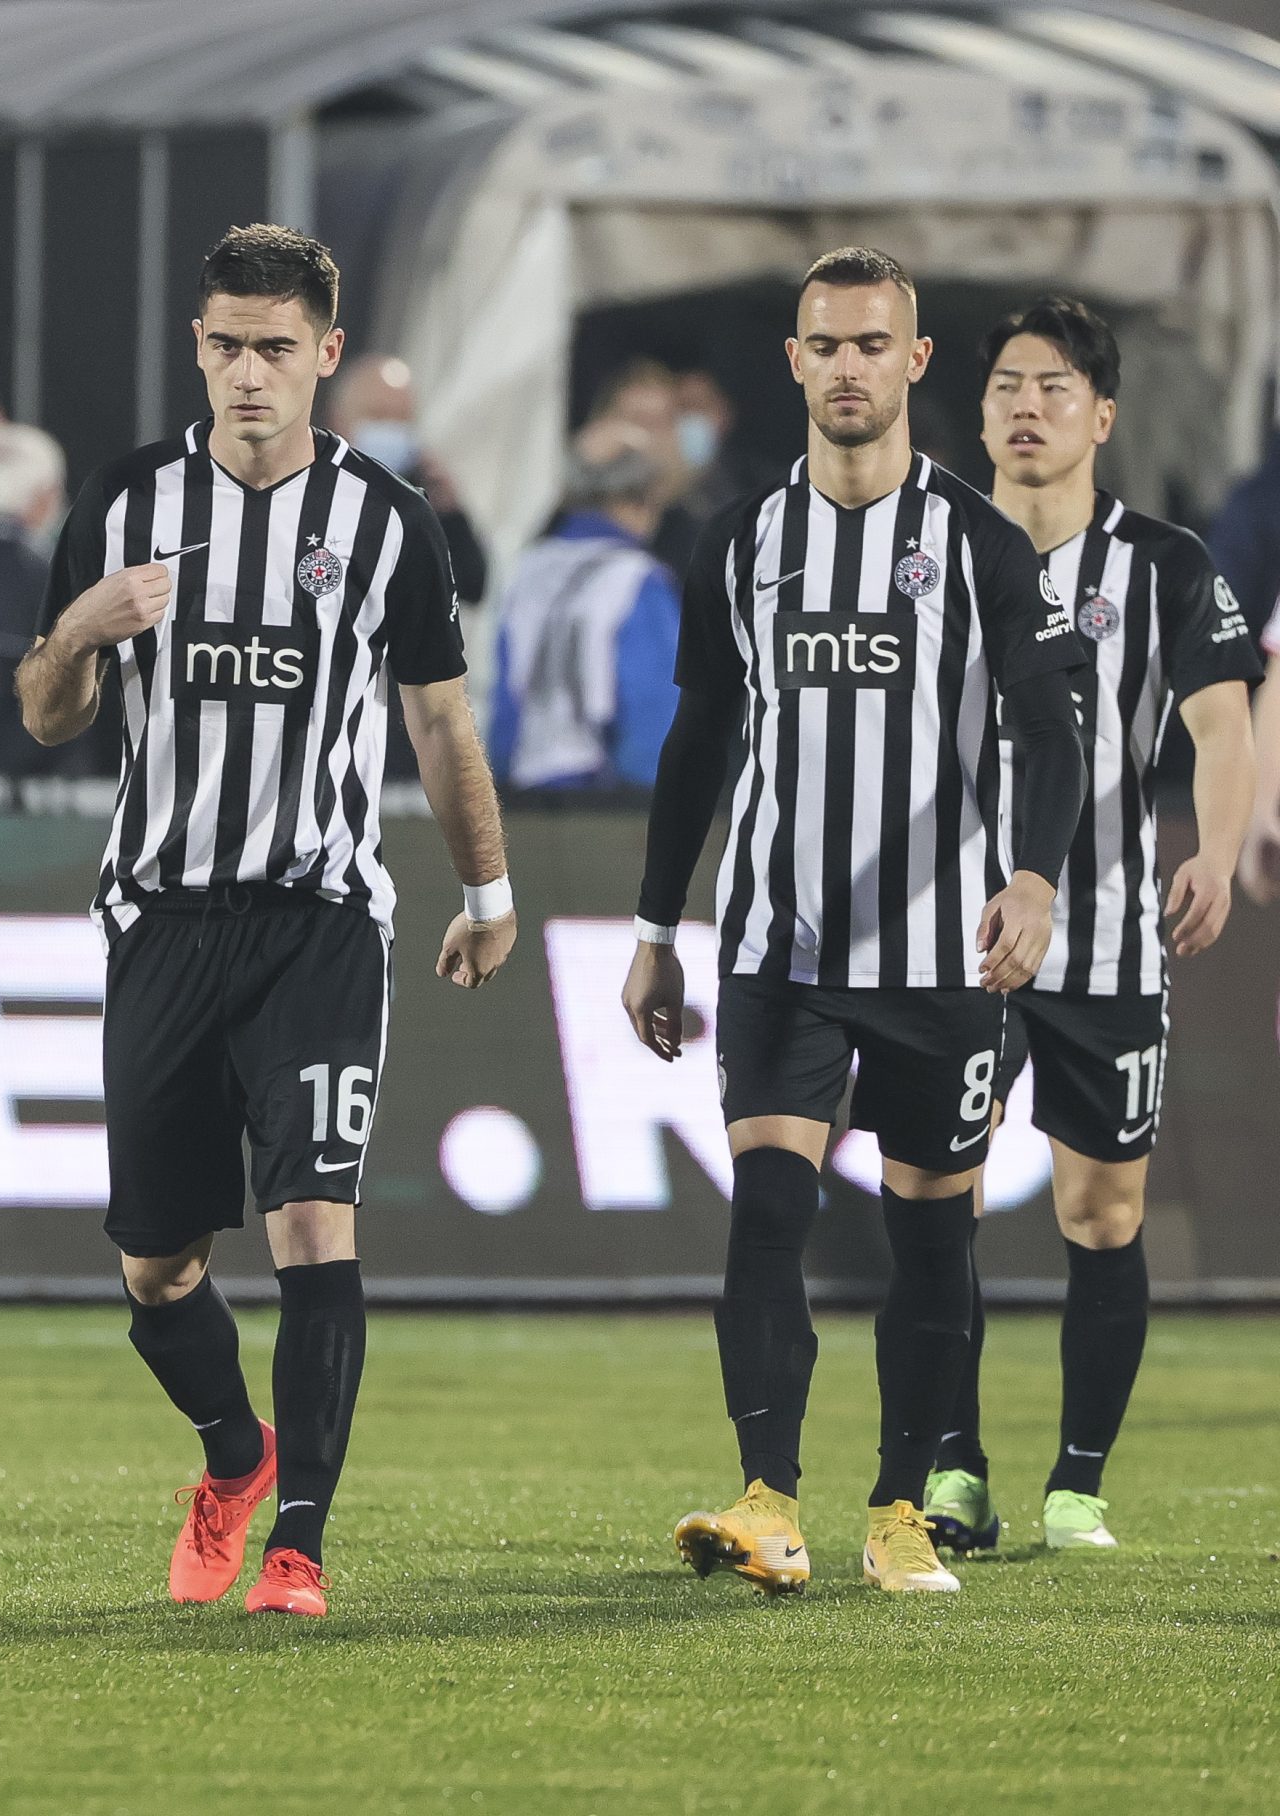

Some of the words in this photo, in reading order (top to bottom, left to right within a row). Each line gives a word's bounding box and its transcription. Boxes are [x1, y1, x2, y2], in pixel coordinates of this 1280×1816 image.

[1035, 622, 1071, 642] ОСИГУ
[1046, 610, 1068, 627] ДУН
[186, 635, 304, 689] mts
[786, 623, 901, 674] mts
[299, 1063, 373, 1145] 16
[959, 1049, 995, 1122] 8
[1115, 1043, 1159, 1121] 11
